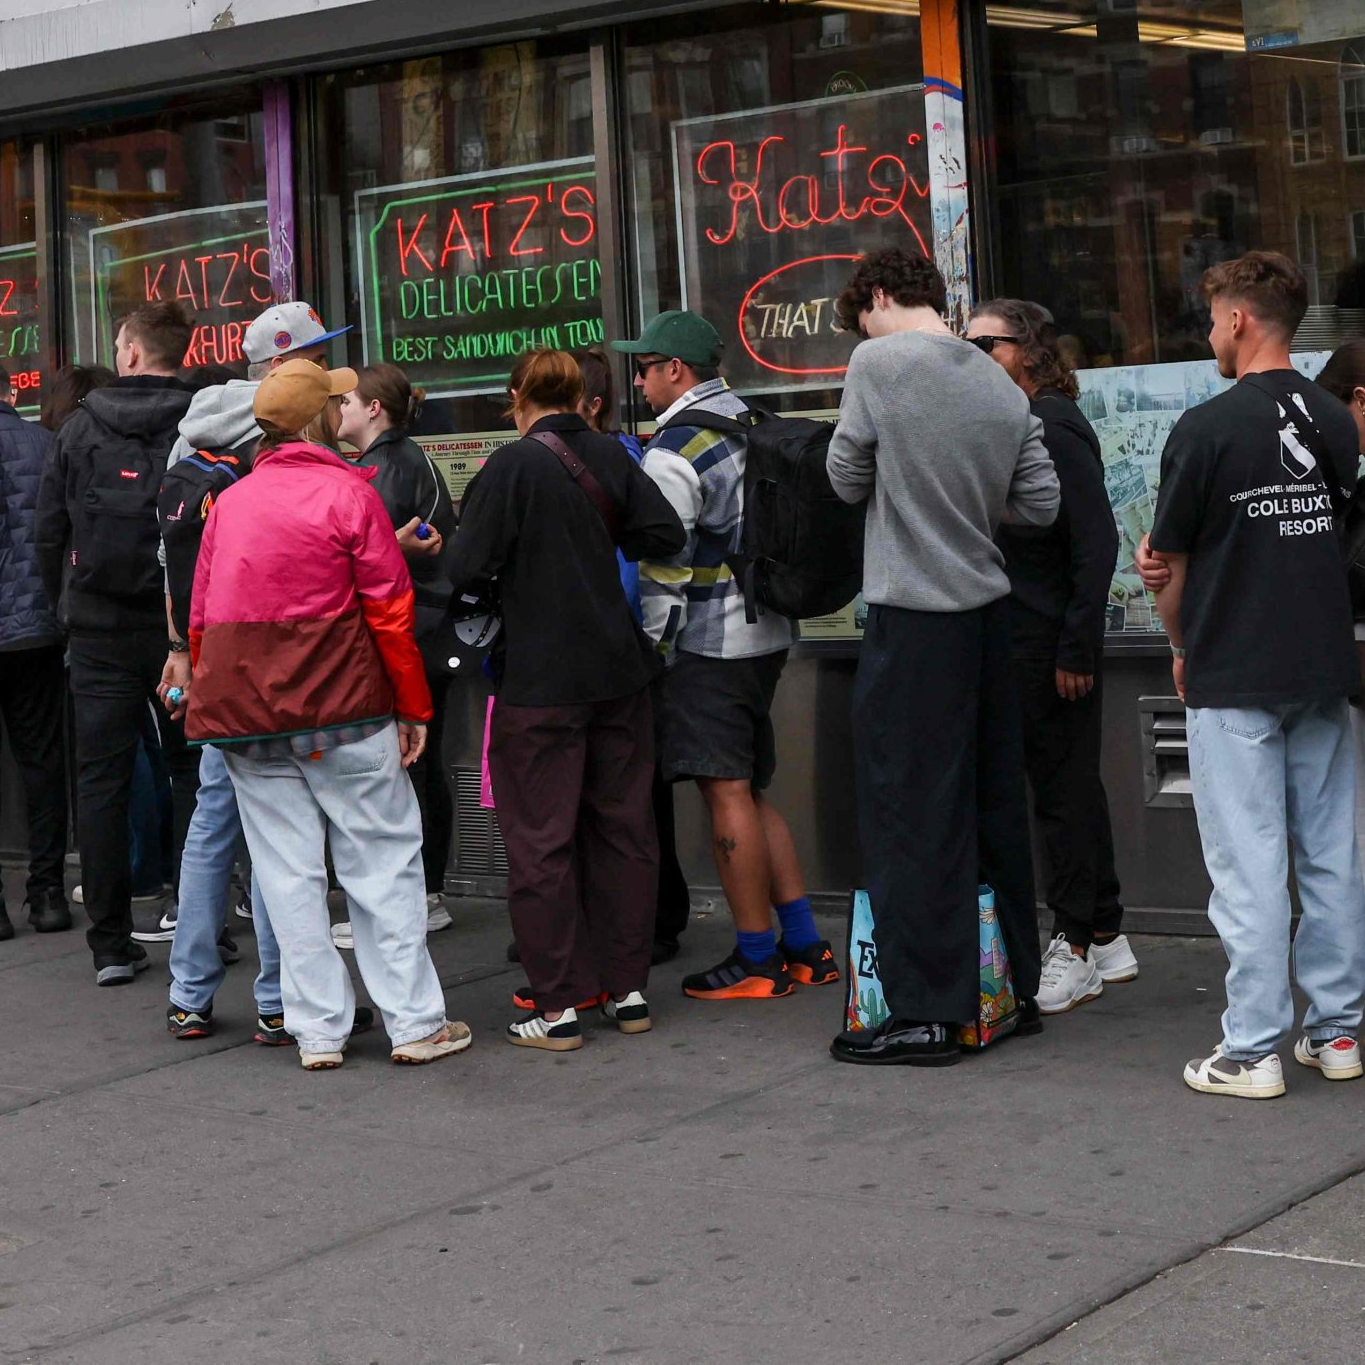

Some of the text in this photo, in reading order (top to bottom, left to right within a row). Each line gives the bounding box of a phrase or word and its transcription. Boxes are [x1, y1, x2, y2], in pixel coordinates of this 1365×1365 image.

[698, 124, 930, 259] Katz'
[398, 183, 596, 276] KATZ'S
[144, 243, 272, 311] KATZ'S
[392, 336, 439, 362] BEST
[443, 329, 535, 361] SANDWICH
[437, 441, 483, 452] DELICATESSEN
[450, 463, 467, 471] 1989
[1247, 498, 1290, 518] COLE
